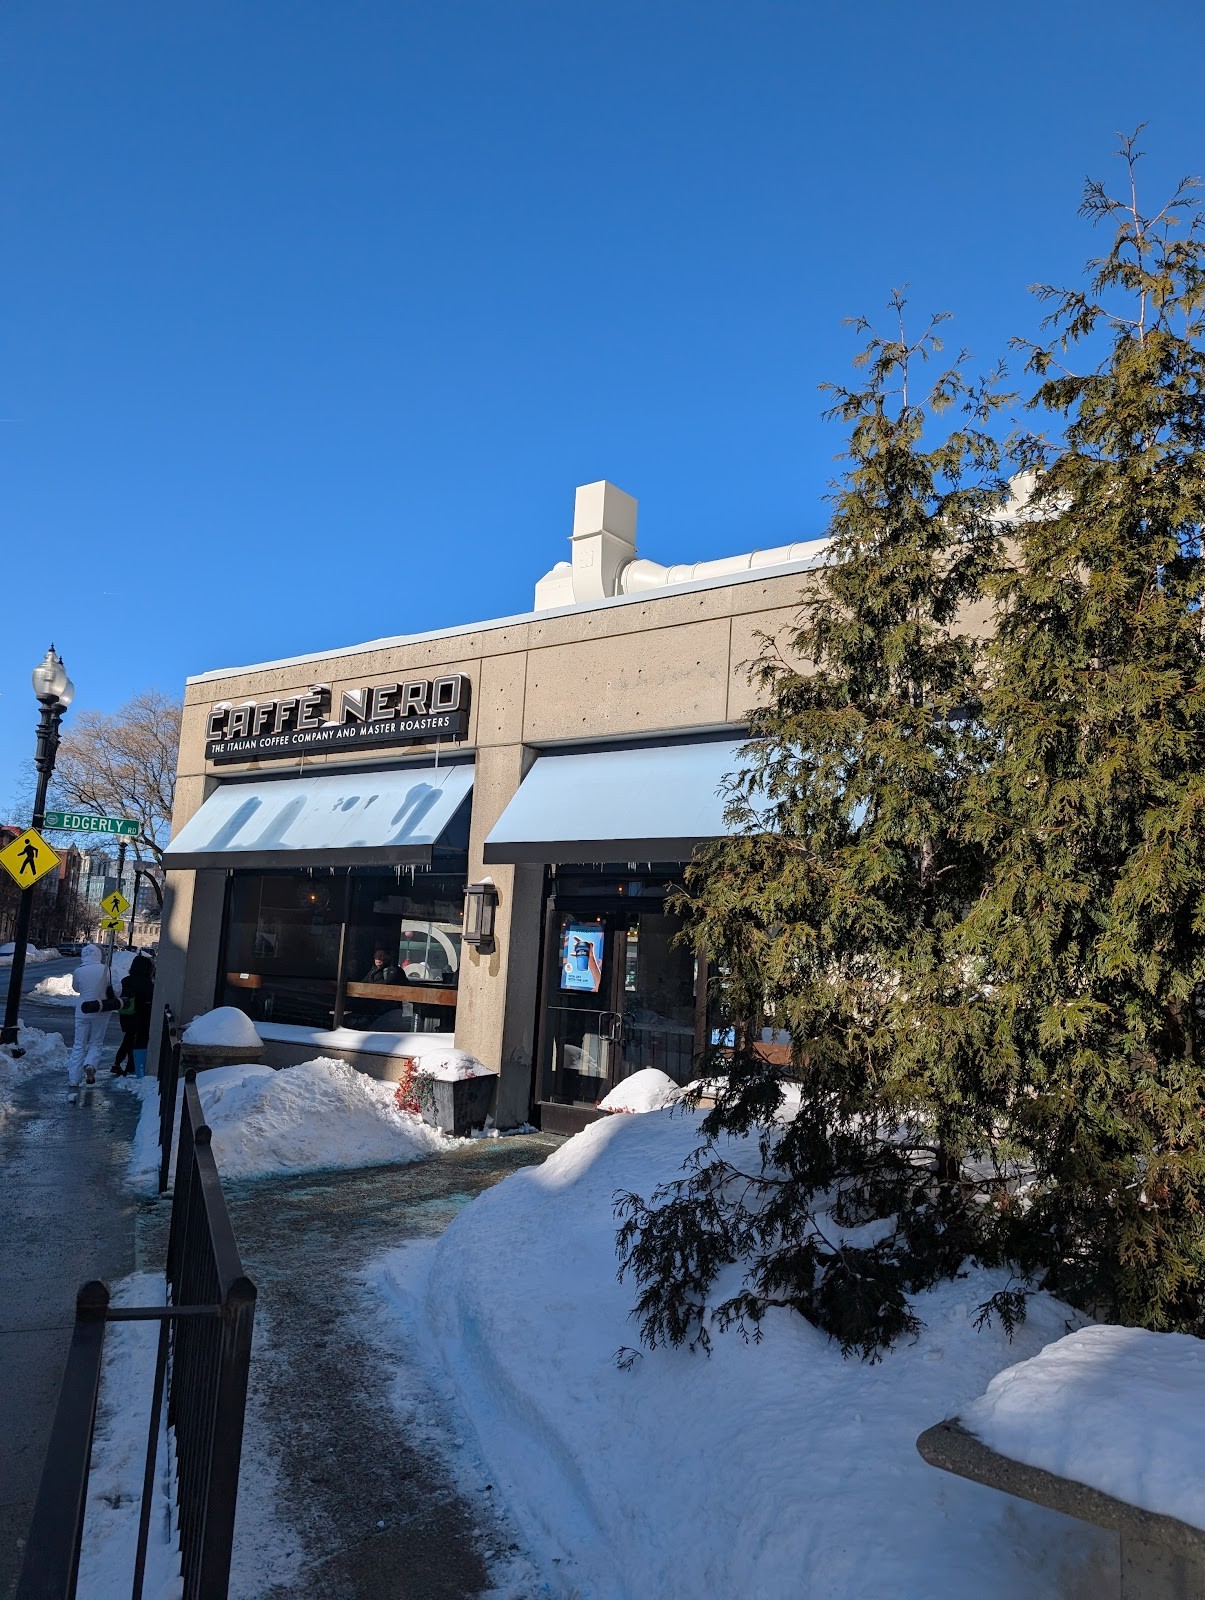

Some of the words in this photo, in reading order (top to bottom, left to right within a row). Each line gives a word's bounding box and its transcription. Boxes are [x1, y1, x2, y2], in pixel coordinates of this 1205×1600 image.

[339, 674, 461, 724] NERO
[212, 745, 224, 753] THE
[227, 741, 256, 751] ITALIAN
[260, 736, 289, 747] COFFEE
[292, 731, 334, 743] COMPANY
[336, 728, 355, 739] AND
[360, 723, 395, 735] MASTER
[400, 717, 450, 731] ROASTERS
[63, 815, 124, 832] EDGERLY
[127, 827, 137, 835] RD
